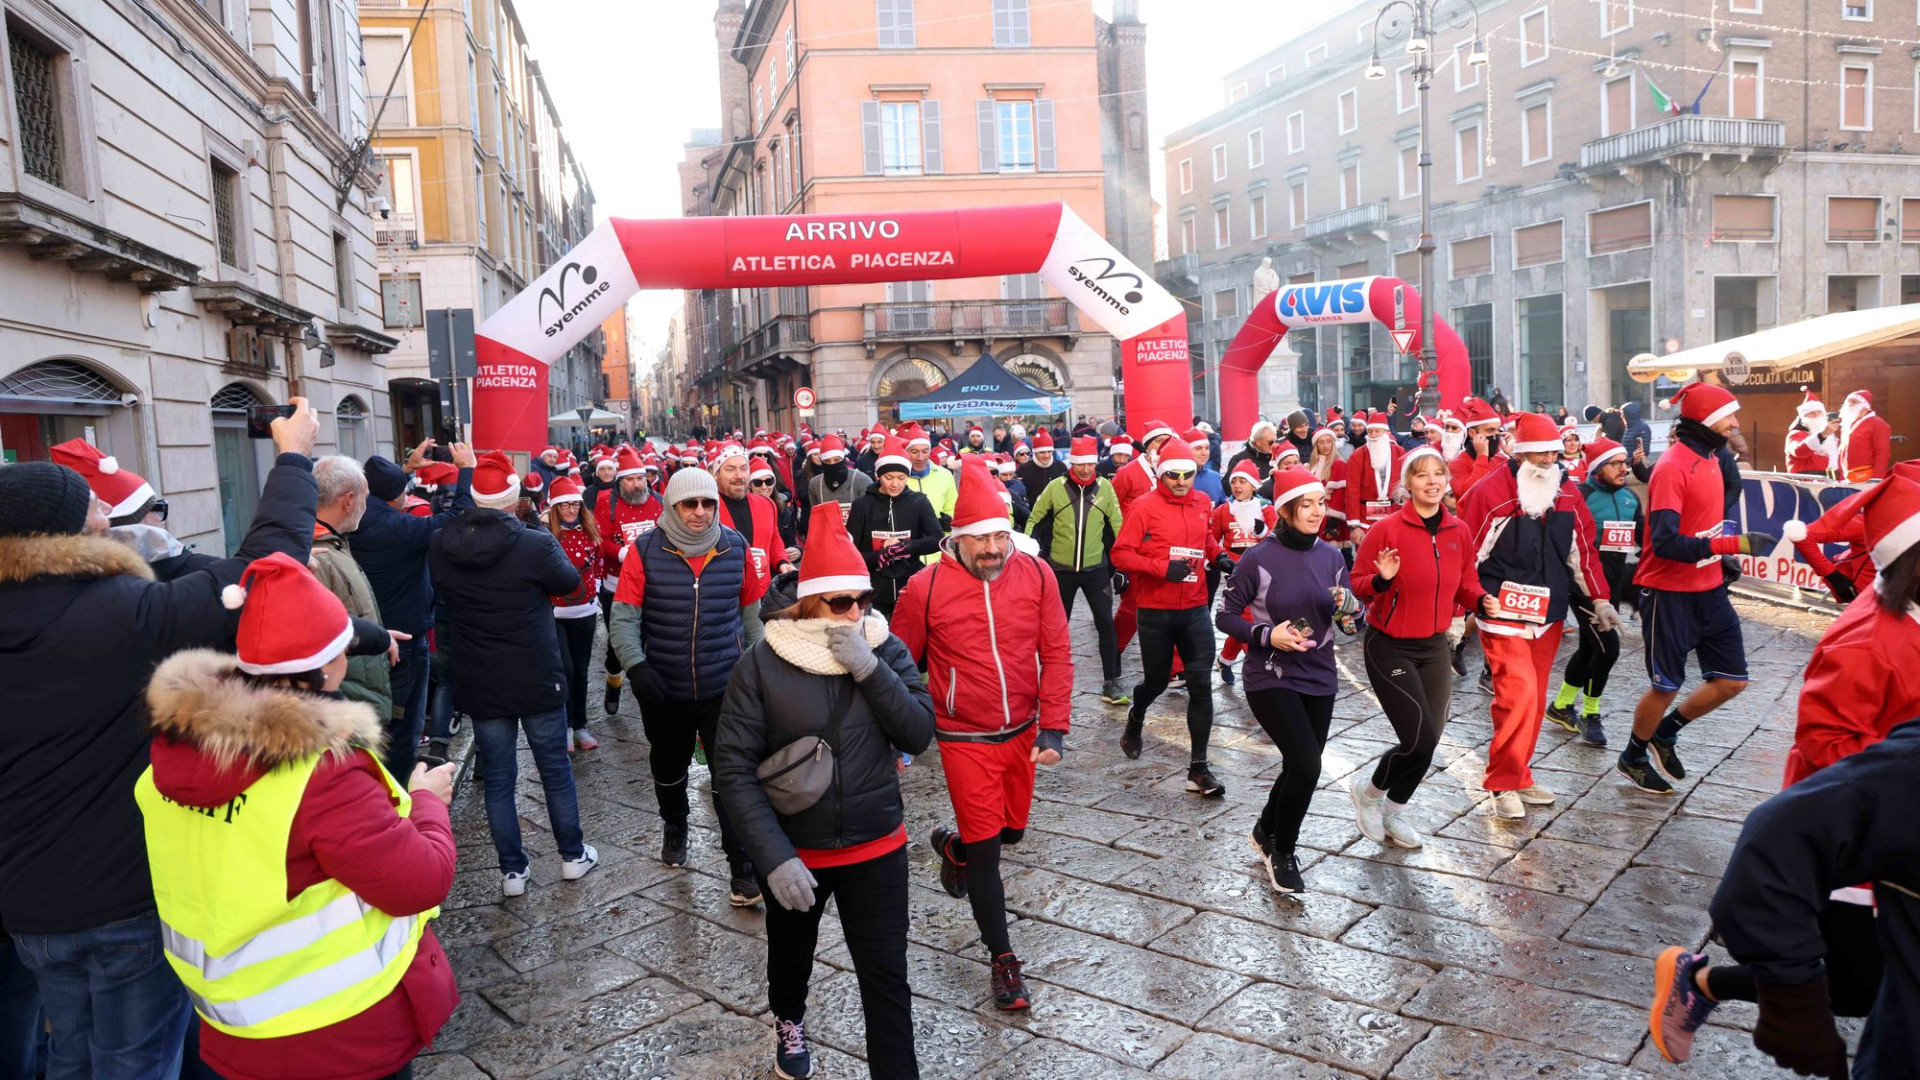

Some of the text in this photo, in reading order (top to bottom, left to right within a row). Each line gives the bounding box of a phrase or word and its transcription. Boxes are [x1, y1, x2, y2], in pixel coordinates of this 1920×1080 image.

[785, 219, 900, 241] ARRIVO
[732, 250, 955, 272] ATLETICA PIACENZA
[1068, 265, 1130, 316] syemme
[1280, 281, 1366, 317] AVIS
[545, 280, 611, 338] syemme
[1137, 339, 1187, 352] ATLETICA
[1137, 350, 1188, 363] PIACENZA
[1728, 356, 1743, 365] VIN
[476, 364, 537, 377] ATLETICA
[1784, 369, 1815, 384] CALDA
[476, 376, 537, 388] PIACENZA
[961, 384, 1000, 393] ENDU
[1608, 529, 1632, 542] 678
[1736, 556, 1767, 579] ale
[1505, 592, 1541, 612] 684
